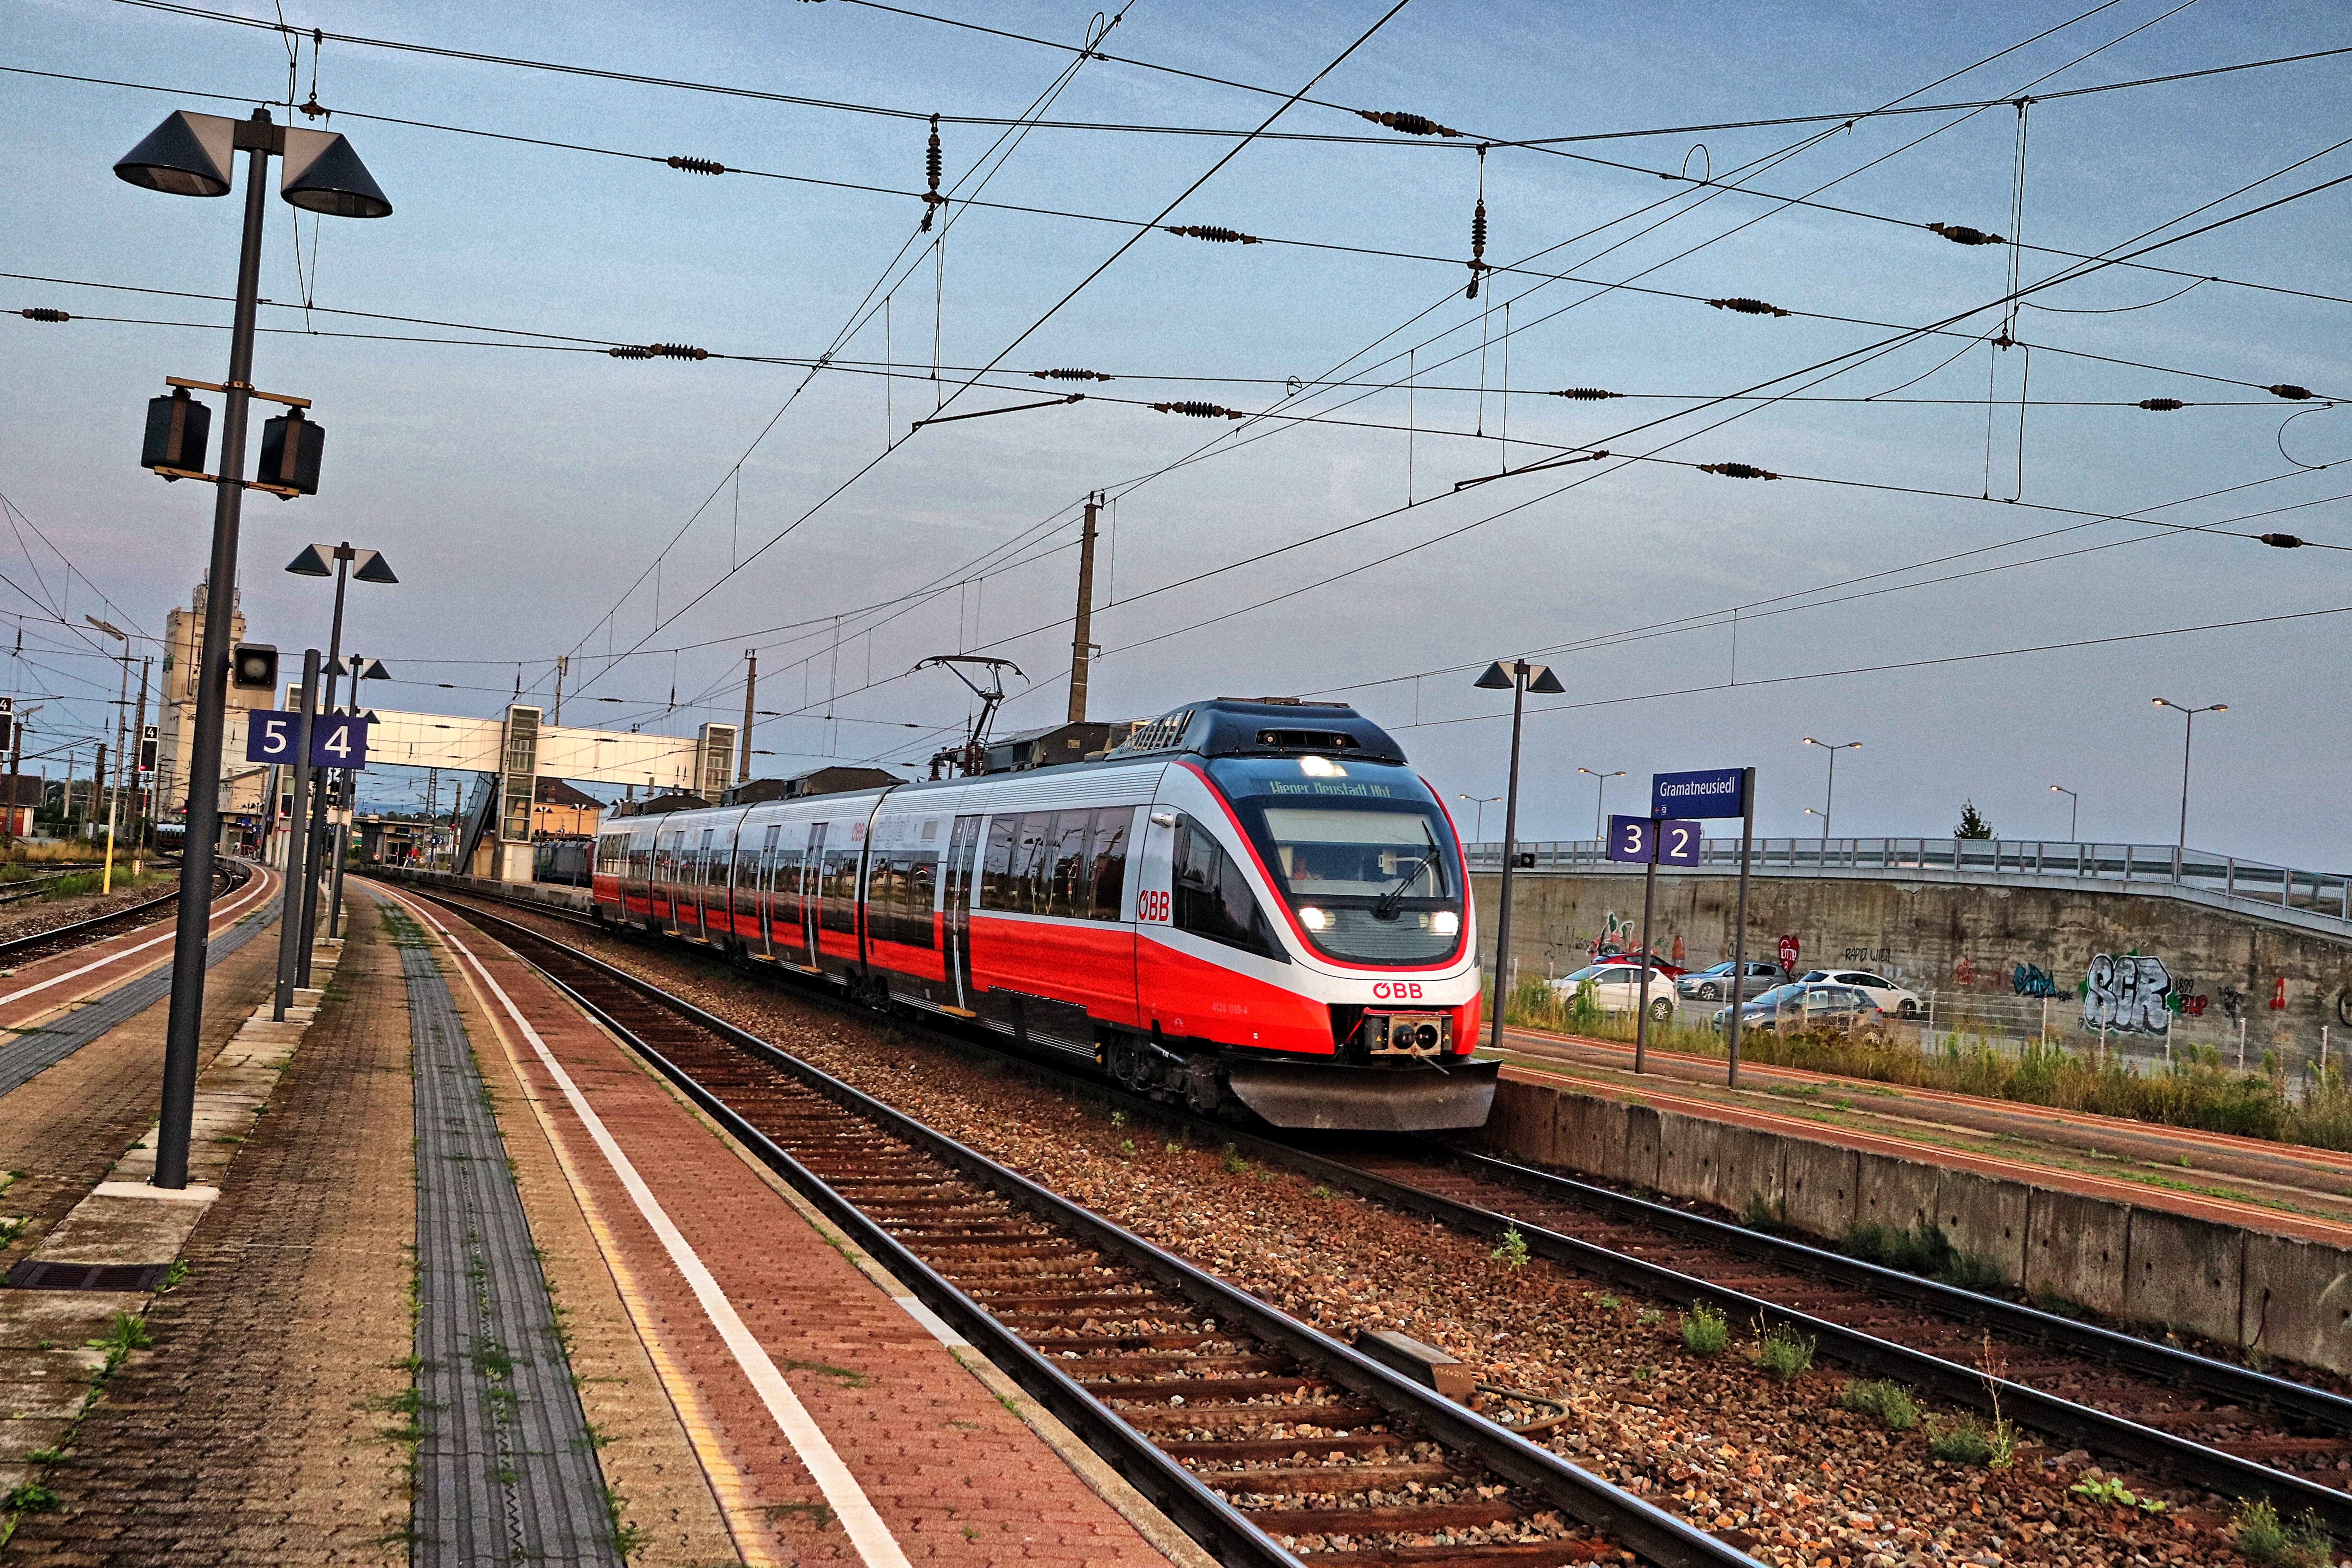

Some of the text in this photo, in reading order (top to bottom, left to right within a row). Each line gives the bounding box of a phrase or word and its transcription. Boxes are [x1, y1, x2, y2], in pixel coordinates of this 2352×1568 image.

[0, 699, 8, 710] 4
[147, 728, 154, 737] 4
[263, 720, 287, 753] 5
[325, 726, 352, 758] 4
[1270, 780, 1390, 797] Wiener Neustadt Hbf
[1660, 776, 1735, 797] Gramatneusiedl
[1624, 824, 1642, 853] 3
[1670, 828, 1688, 857] 2
[1139, 889, 1170, 922] ÖBB
[1373, 982, 1423, 999] ÖBB
[2175, 978, 2194, 993] 1899
